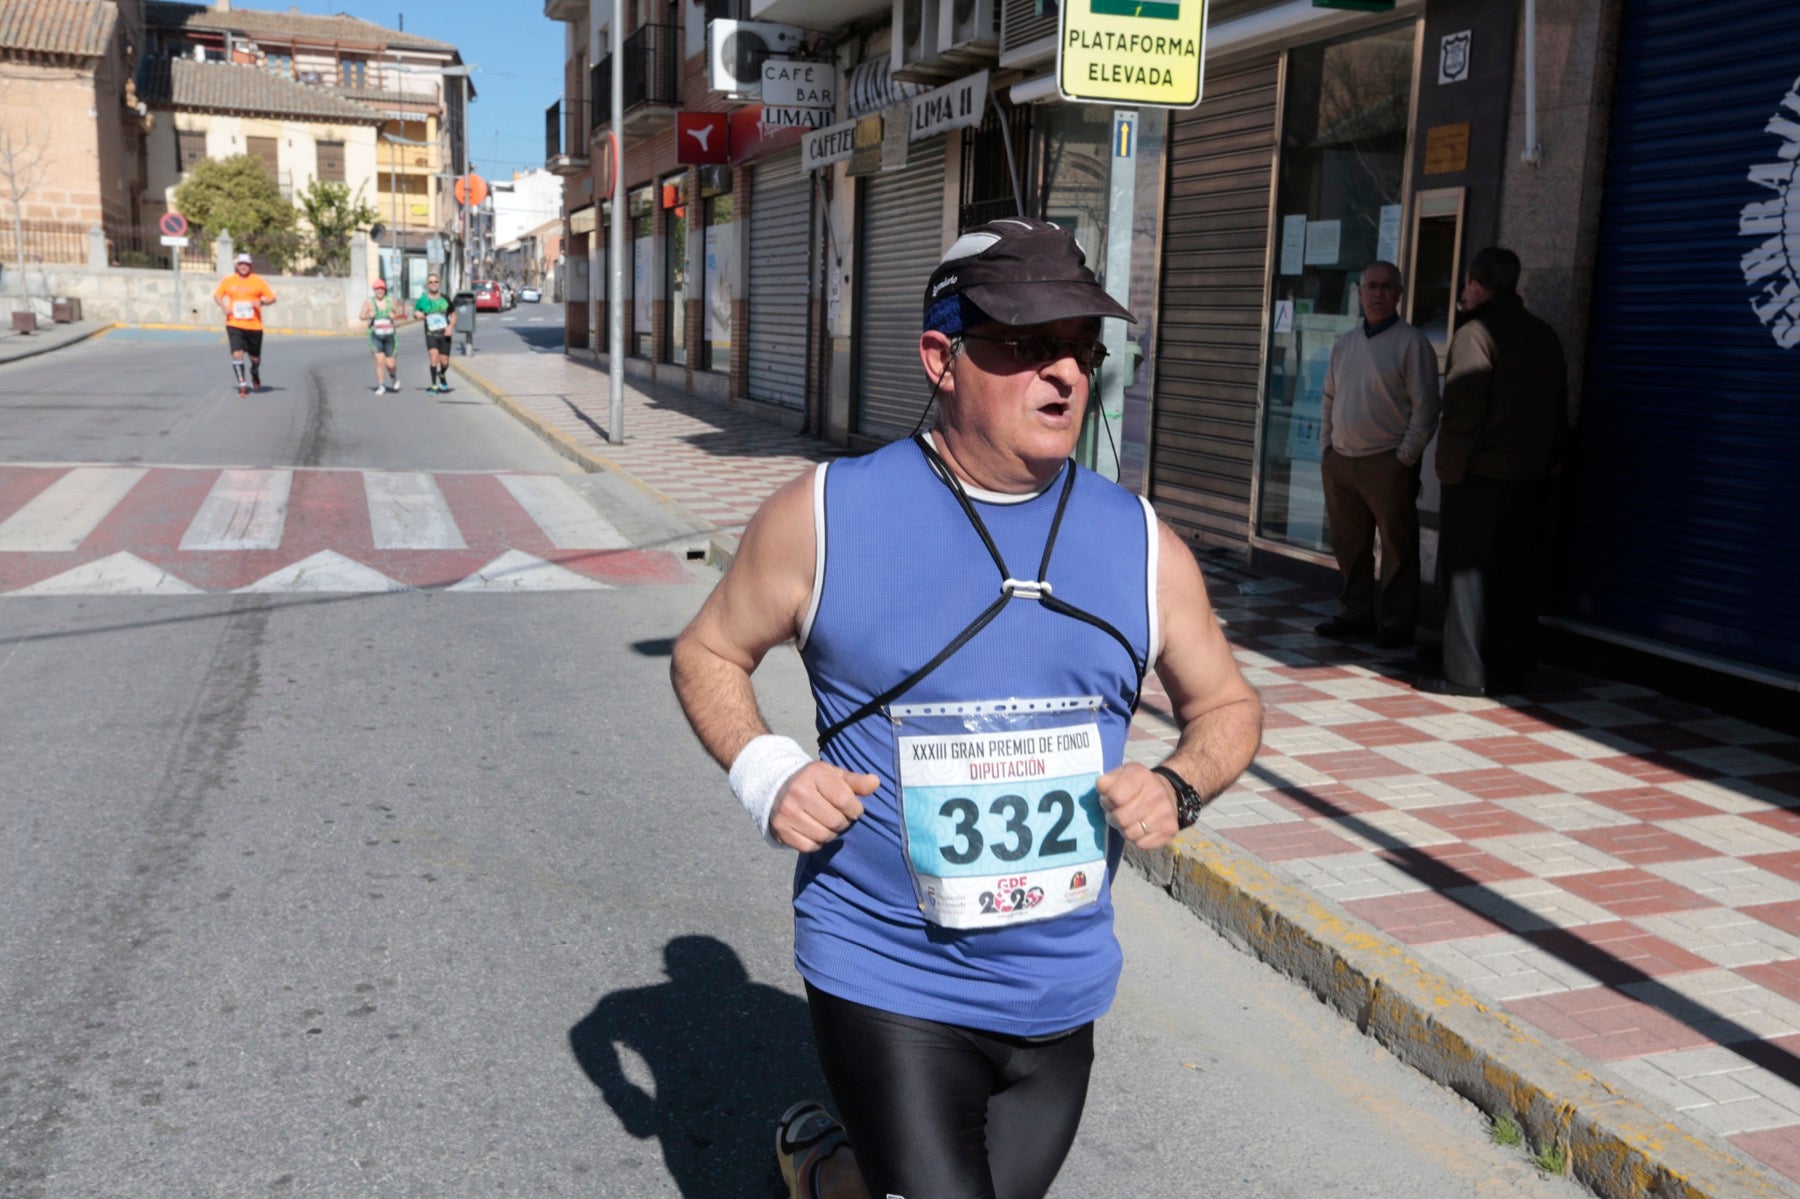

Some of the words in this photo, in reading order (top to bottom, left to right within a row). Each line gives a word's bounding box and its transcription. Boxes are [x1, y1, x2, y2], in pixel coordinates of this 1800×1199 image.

[1069, 29, 1196, 57] PLATAFORMA
[765, 66, 815, 83] CAFÉ
[1089, 62, 1174, 87] ELEVADA
[796, 88, 832, 103] BAR
[916, 94, 954, 130] LIMA
[912, 742, 947, 761] XXXIII
[951, 740, 985, 760] GRAN
[989, 738, 1035, 757] PREMIO
[1039, 736, 1053, 754] DE
[1057, 731, 1090, 751] FONDO
[970, 757, 1046, 781] DIPUTACIÓN
[939, 789, 1078, 865] 332
